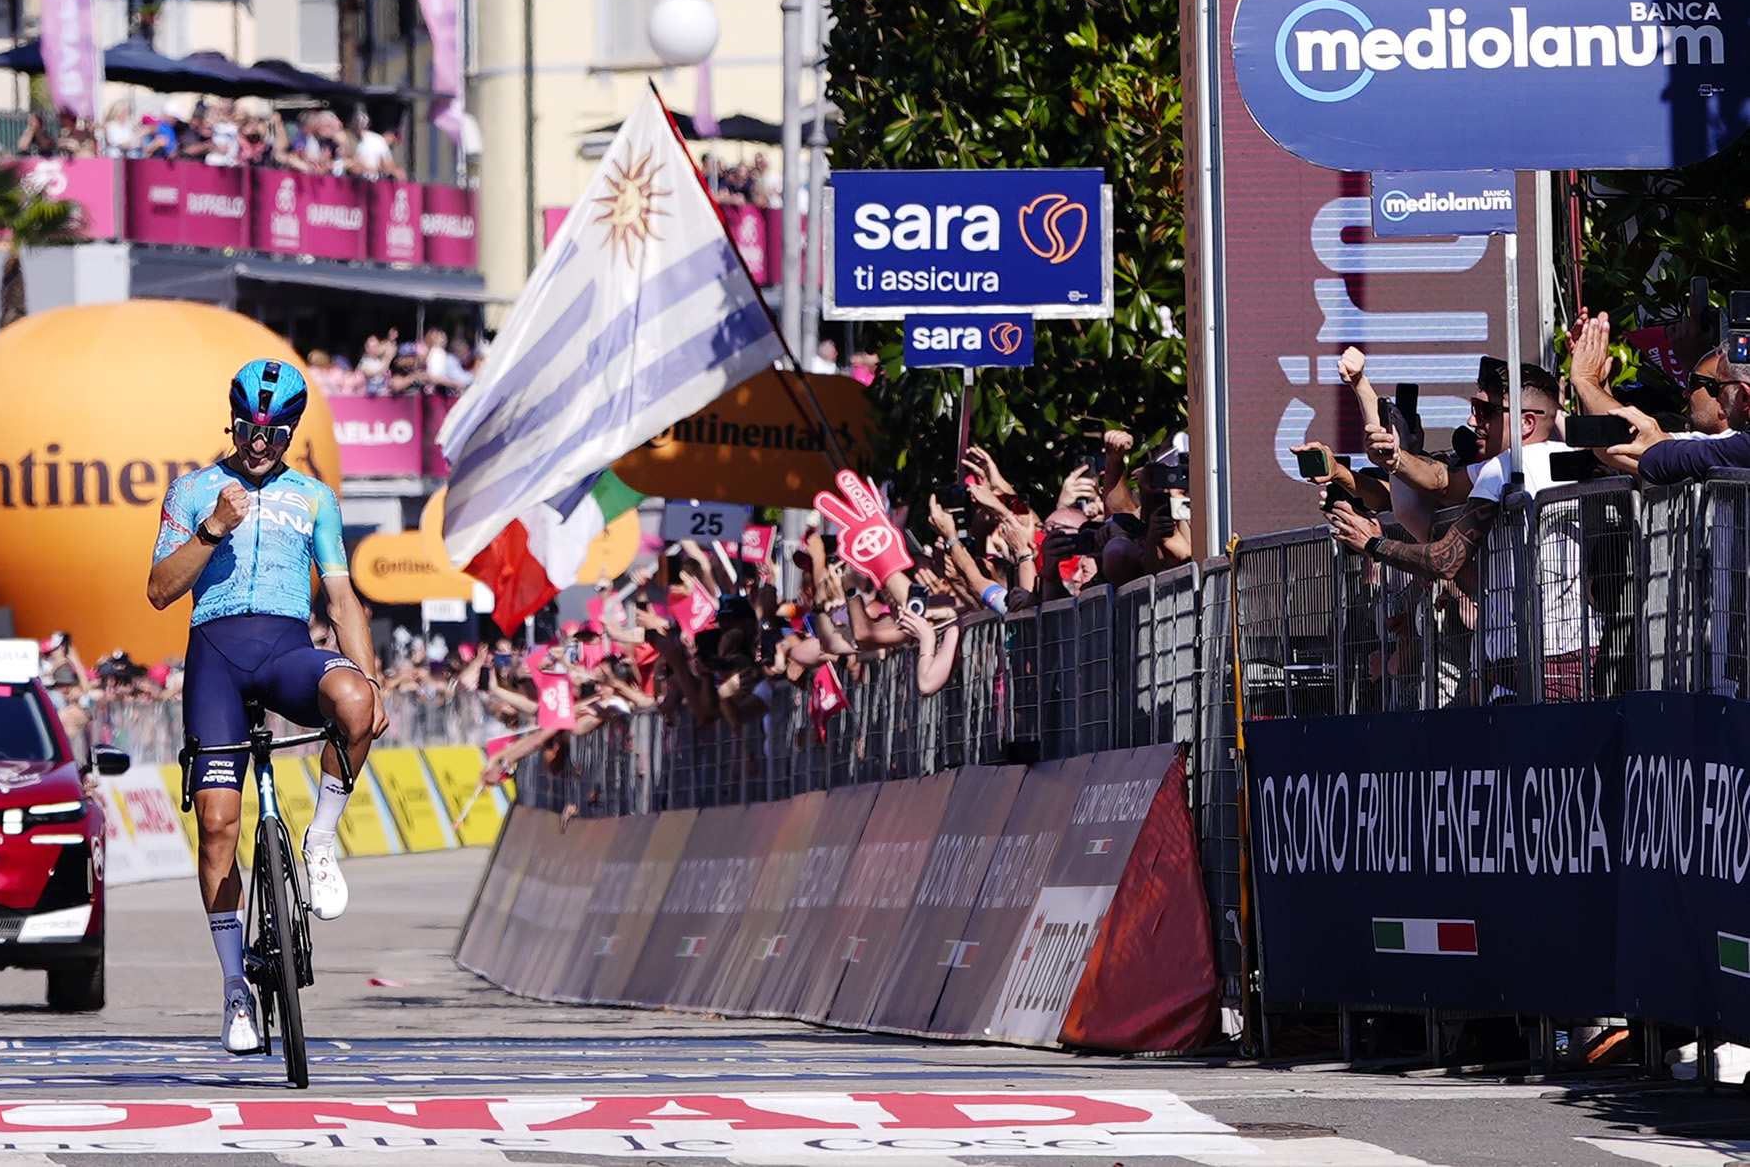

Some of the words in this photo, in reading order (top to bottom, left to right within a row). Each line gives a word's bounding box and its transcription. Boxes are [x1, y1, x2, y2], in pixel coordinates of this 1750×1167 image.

[1630, 1, 1721, 22] BANCA
[1295, 7, 1725, 73] mediolanum
[1386, 190, 1512, 215] mediolanum
[853, 203, 1000, 252] sara
[853, 265, 874, 290] ti
[880, 266, 999, 293] assicura
[912, 326, 982, 350] sara
[842, 475, 879, 518] TOYOTA
[242, 506, 315, 538] TANA
[690, 513, 724, 536] 25
[202, 775, 238, 784] ASTANA
[1257, 775, 1279, 875] IO
[1282, 771, 1349, 875] SONO
[1355, 771, 1413, 874] FRIULI
[1420, 765, 1519, 877] VENEZIA
[1522, 761, 1611, 876] GIULIA
[1640, 753, 1695, 875] SONO
[620, 1135, 734, 1152] le
